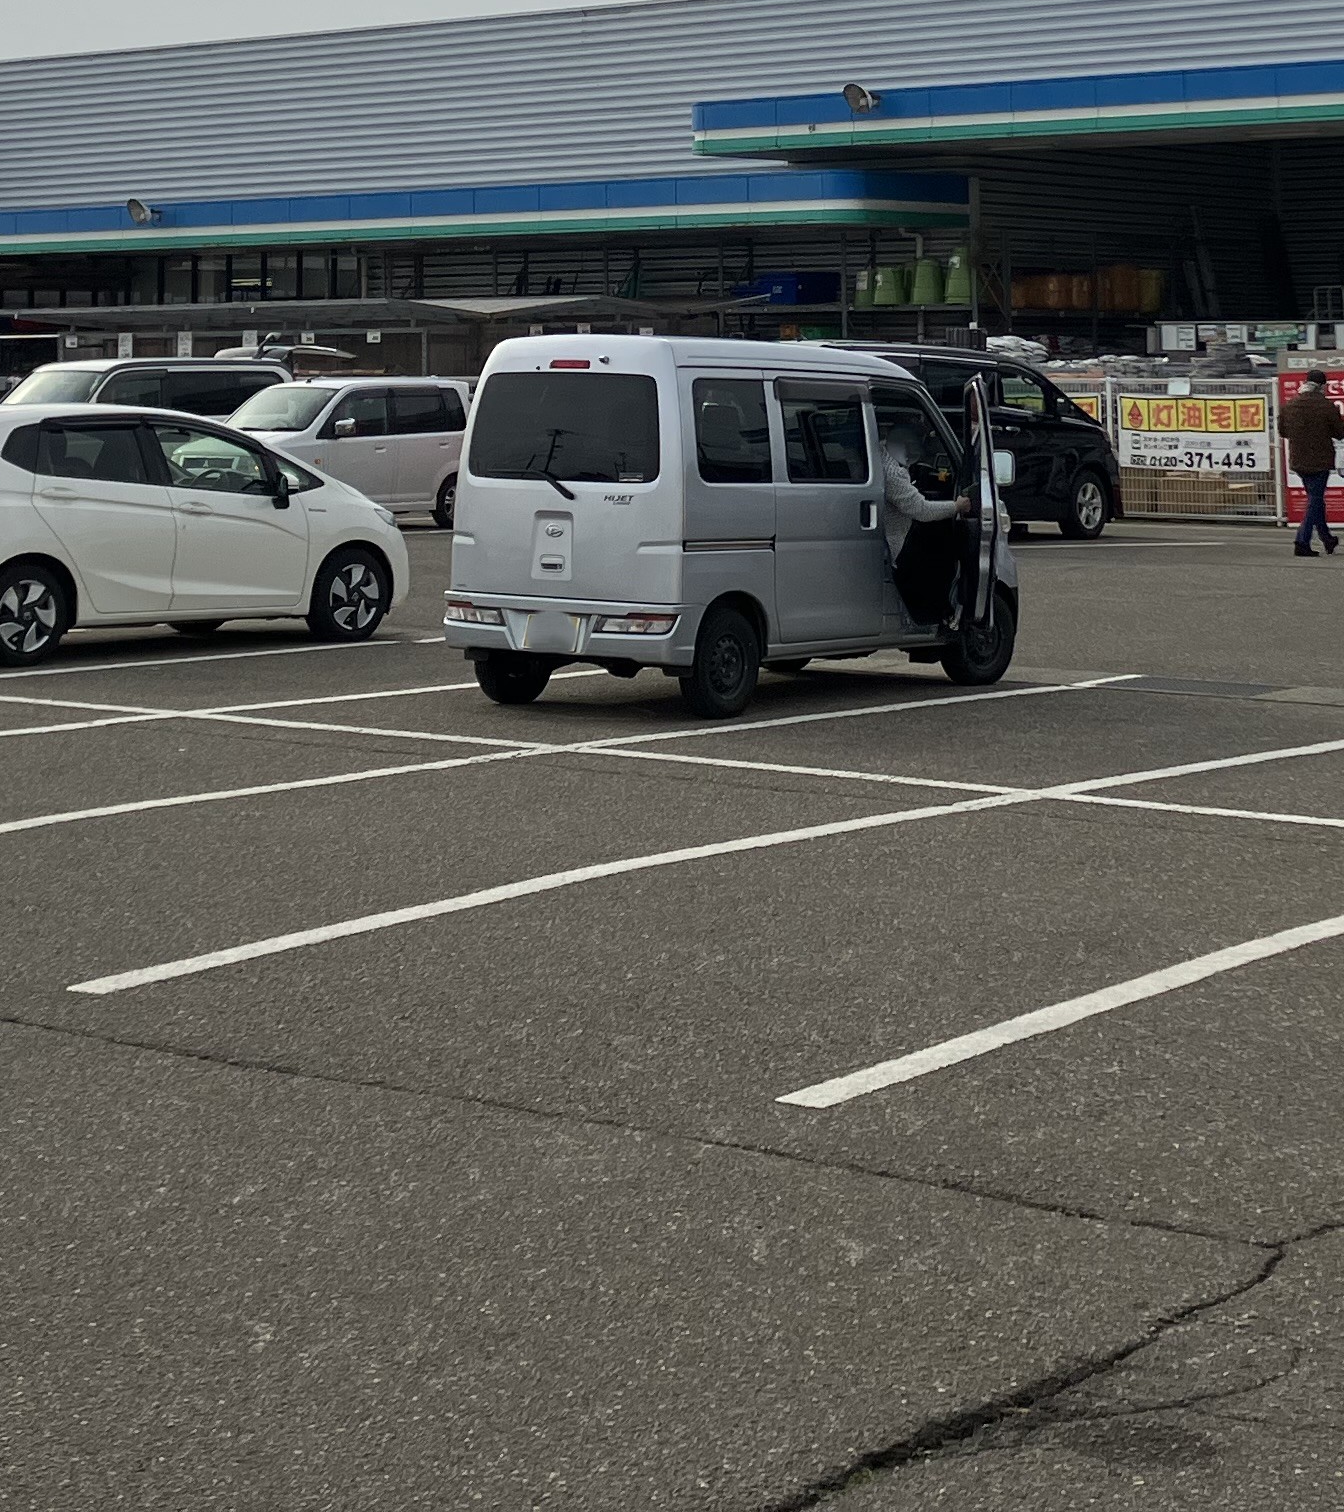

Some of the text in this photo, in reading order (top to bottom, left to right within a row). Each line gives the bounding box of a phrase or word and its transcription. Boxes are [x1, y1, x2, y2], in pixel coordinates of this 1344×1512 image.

[1152, 403, 1262, 429] 灯油宅配
[1149, 451, 1256, 469] 0120-371-445
